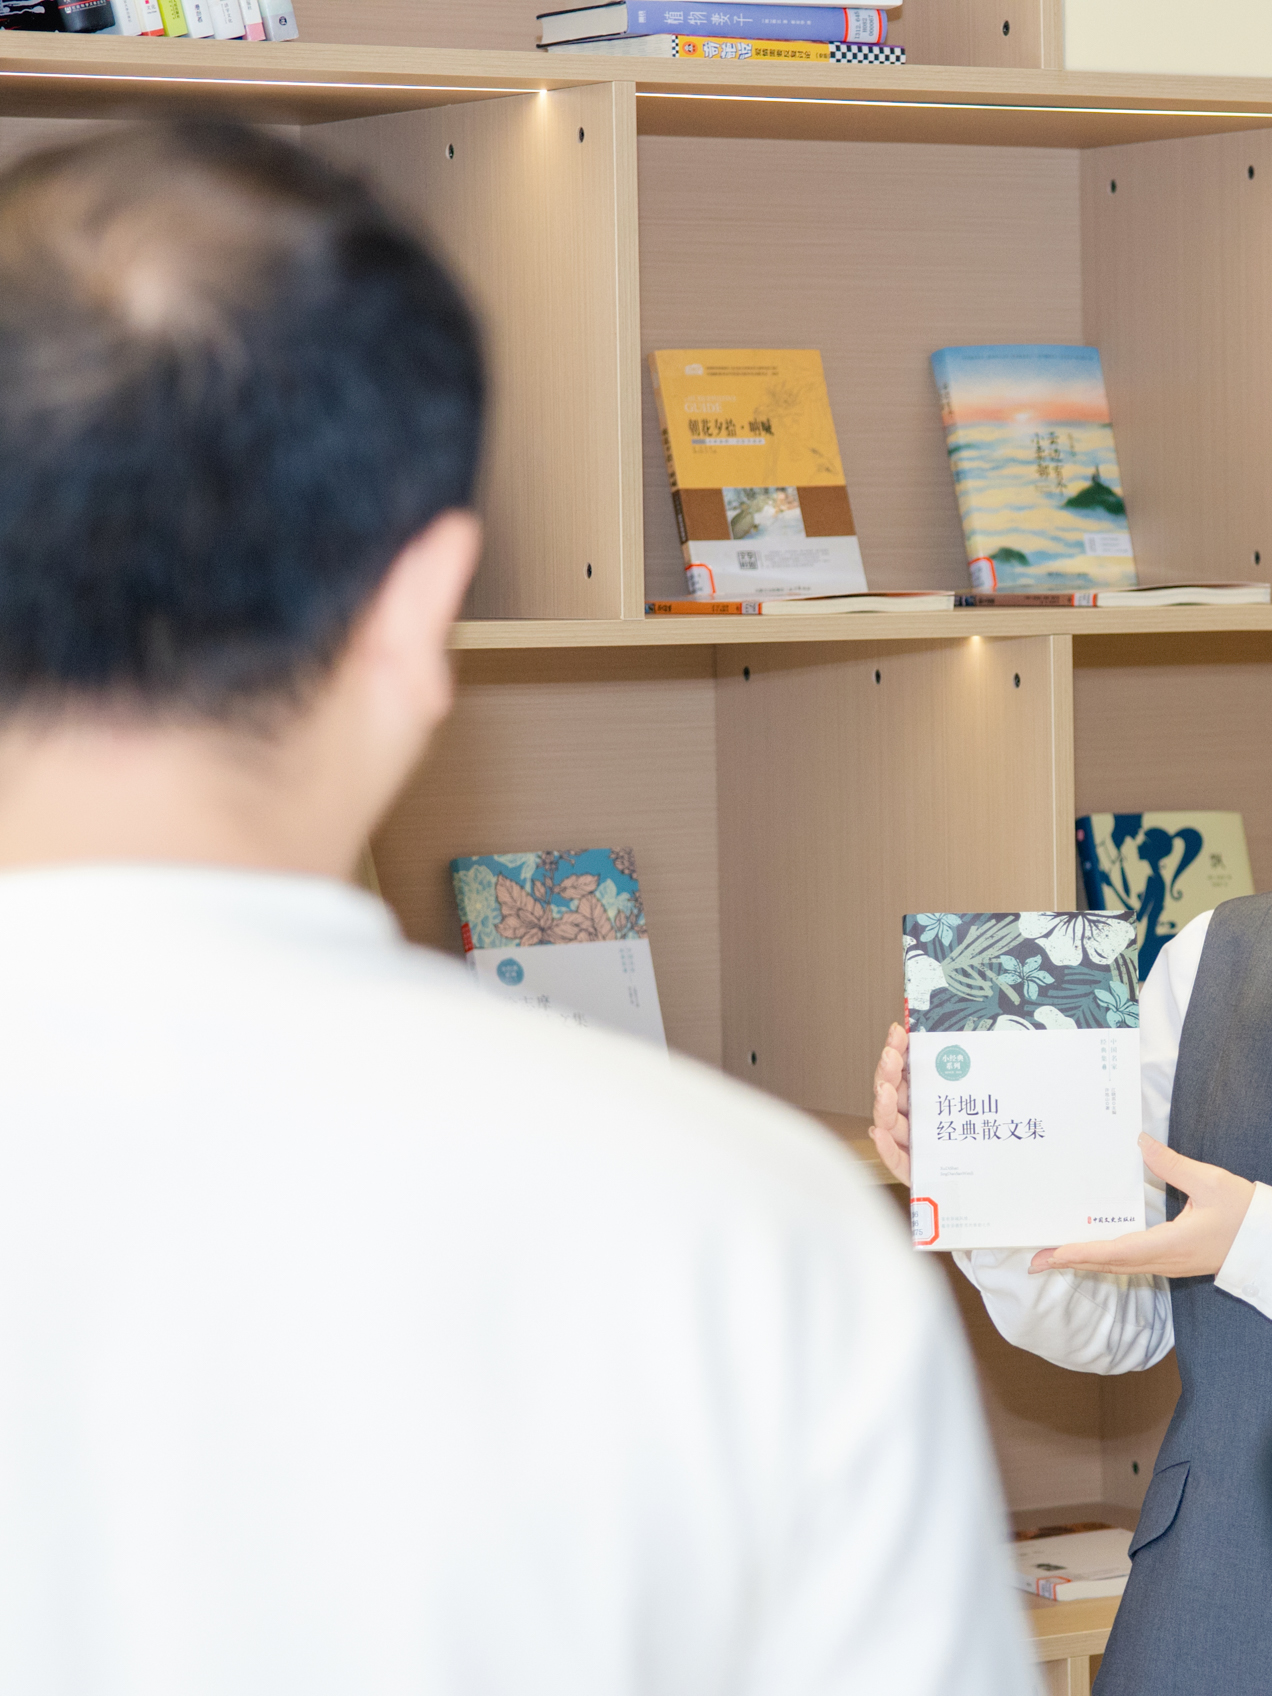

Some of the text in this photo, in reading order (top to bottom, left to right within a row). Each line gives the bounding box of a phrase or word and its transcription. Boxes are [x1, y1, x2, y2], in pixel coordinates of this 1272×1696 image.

[664, 10, 753, 26] 植物妻子
[684, 402, 722, 413] GUIDE
[942, 1054, 964, 1062] 小经典
[946, 1062, 961, 1070] 系列
[936, 1094, 998, 1116] 许地山
[936, 1118, 1045, 1141] 经典散文集
